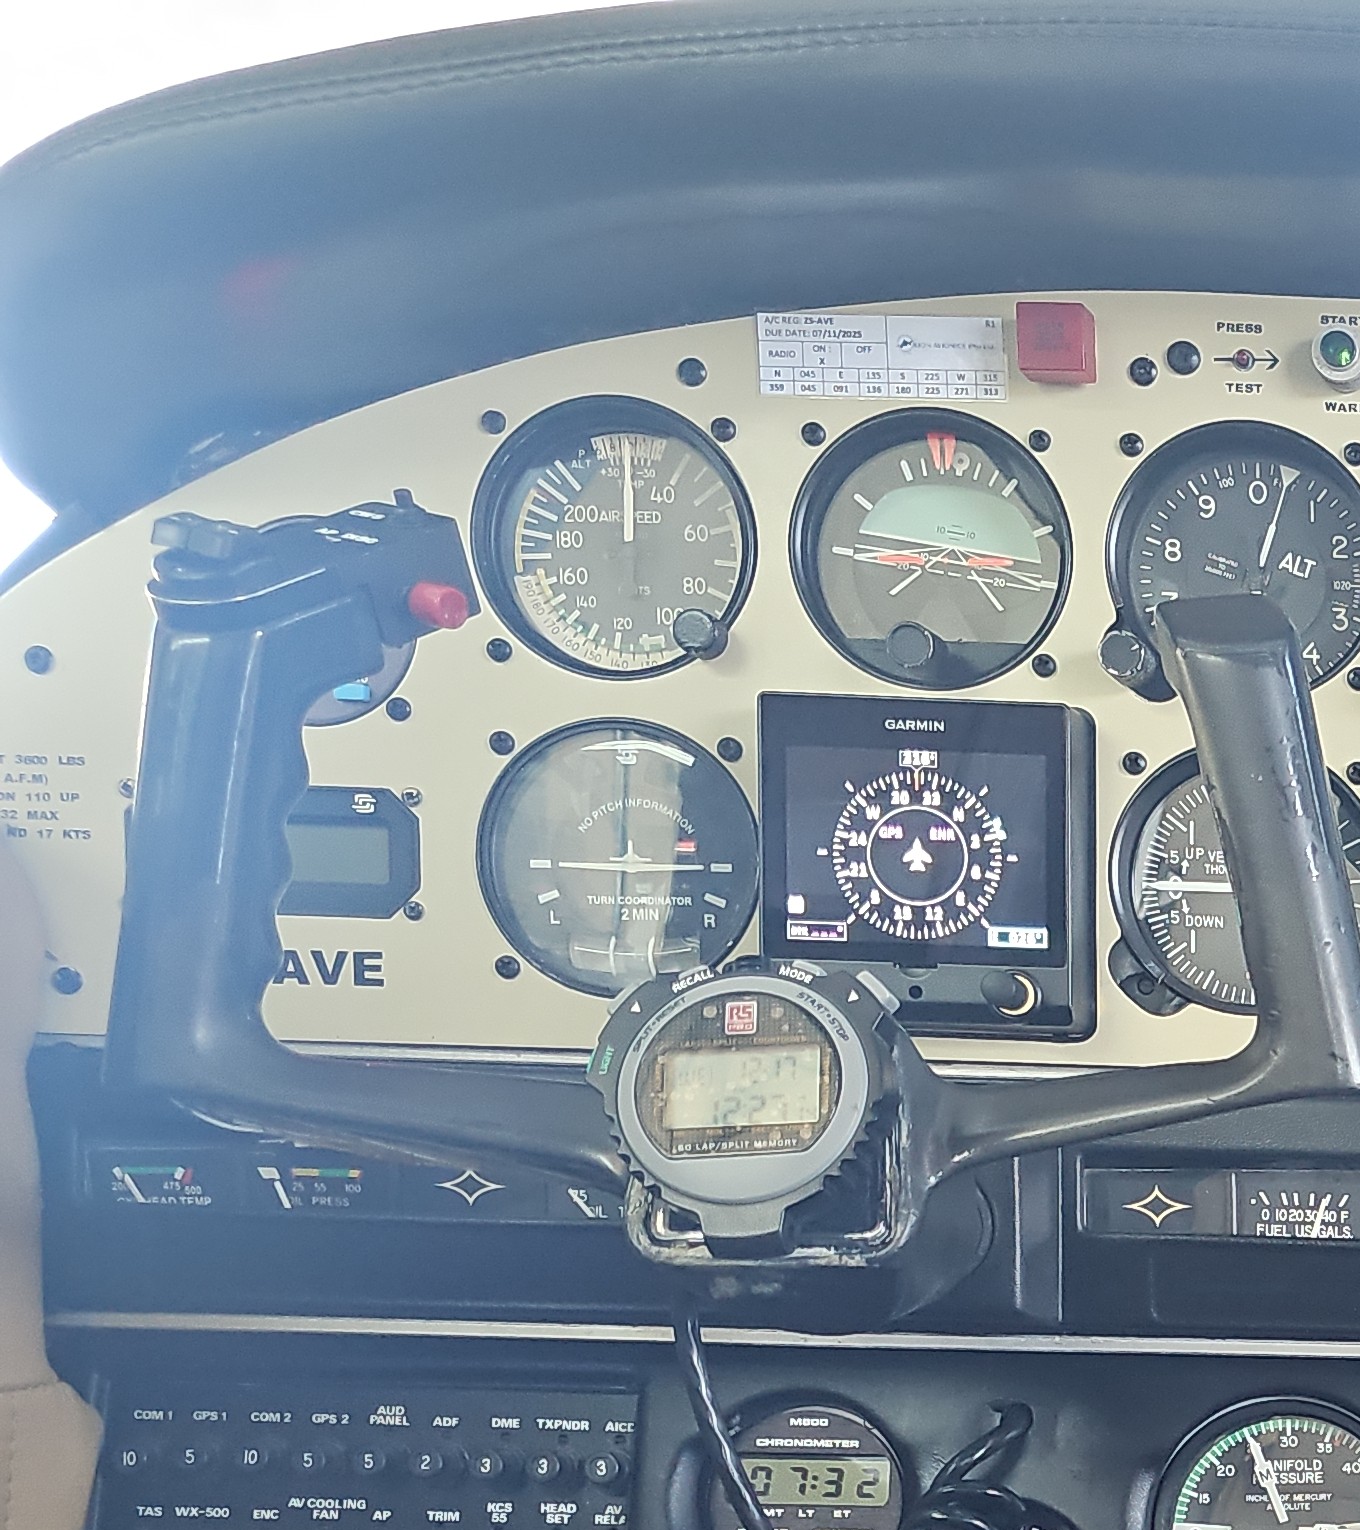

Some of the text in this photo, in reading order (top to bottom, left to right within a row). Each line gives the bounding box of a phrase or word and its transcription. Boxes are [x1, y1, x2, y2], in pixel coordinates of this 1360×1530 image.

[765, 316, 780, 324] A/C
[804, 317, 834, 325] ZS-AVE
[765, 329, 862, 339] DUE DATE: 07/11/2025
[1216, 322, 1262, 335] PRESS
[768, 350, 796, 359] RADIO
[1225, 383, 1263, 394] TEST
[651, 486, 674, 502] 40
[564, 506, 660, 523] 200 AIREED
[556, 531, 582, 547] 180
[684, 526, 708, 541] 60
[1279, 552, 1316, 578] ALT
[560, 568, 588, 584] 160
[682, 578, 706, 594] 80
[885, 719, 945, 732] GARMIN
[15, 755, 85, 766] 3600 LBS
[26, 792, 79, 802] 110 UP
[28, 810, 59, 821] MAX
[578, 799, 695, 834] NO PITCH INFORMATION
[38, 829, 91, 839] 17 KTS
[1185, 848, 1204, 860] UP
[588, 896, 692, 906] TURN COORDINATOR
[621, 910, 659, 920] 2 MIN
[1185, 916, 1224, 928] DOWN
[272, 951, 384, 987] AVE
[779, 966, 814, 984] MODE
[672, 970, 714, 993] RECALL
[1257, 1226, 1291, 1237] FUEL
[369, 1415, 409, 1426] PANEL
[536, 1418, 589, 1431] TXPNDR
[756, 1438, 859, 1448] CHRONOMETER
[288, 1498, 366, 1510] AV COOLING
[175, 1507, 230, 1518] WX-500
[427, 1511, 460, 1522] TRIM
